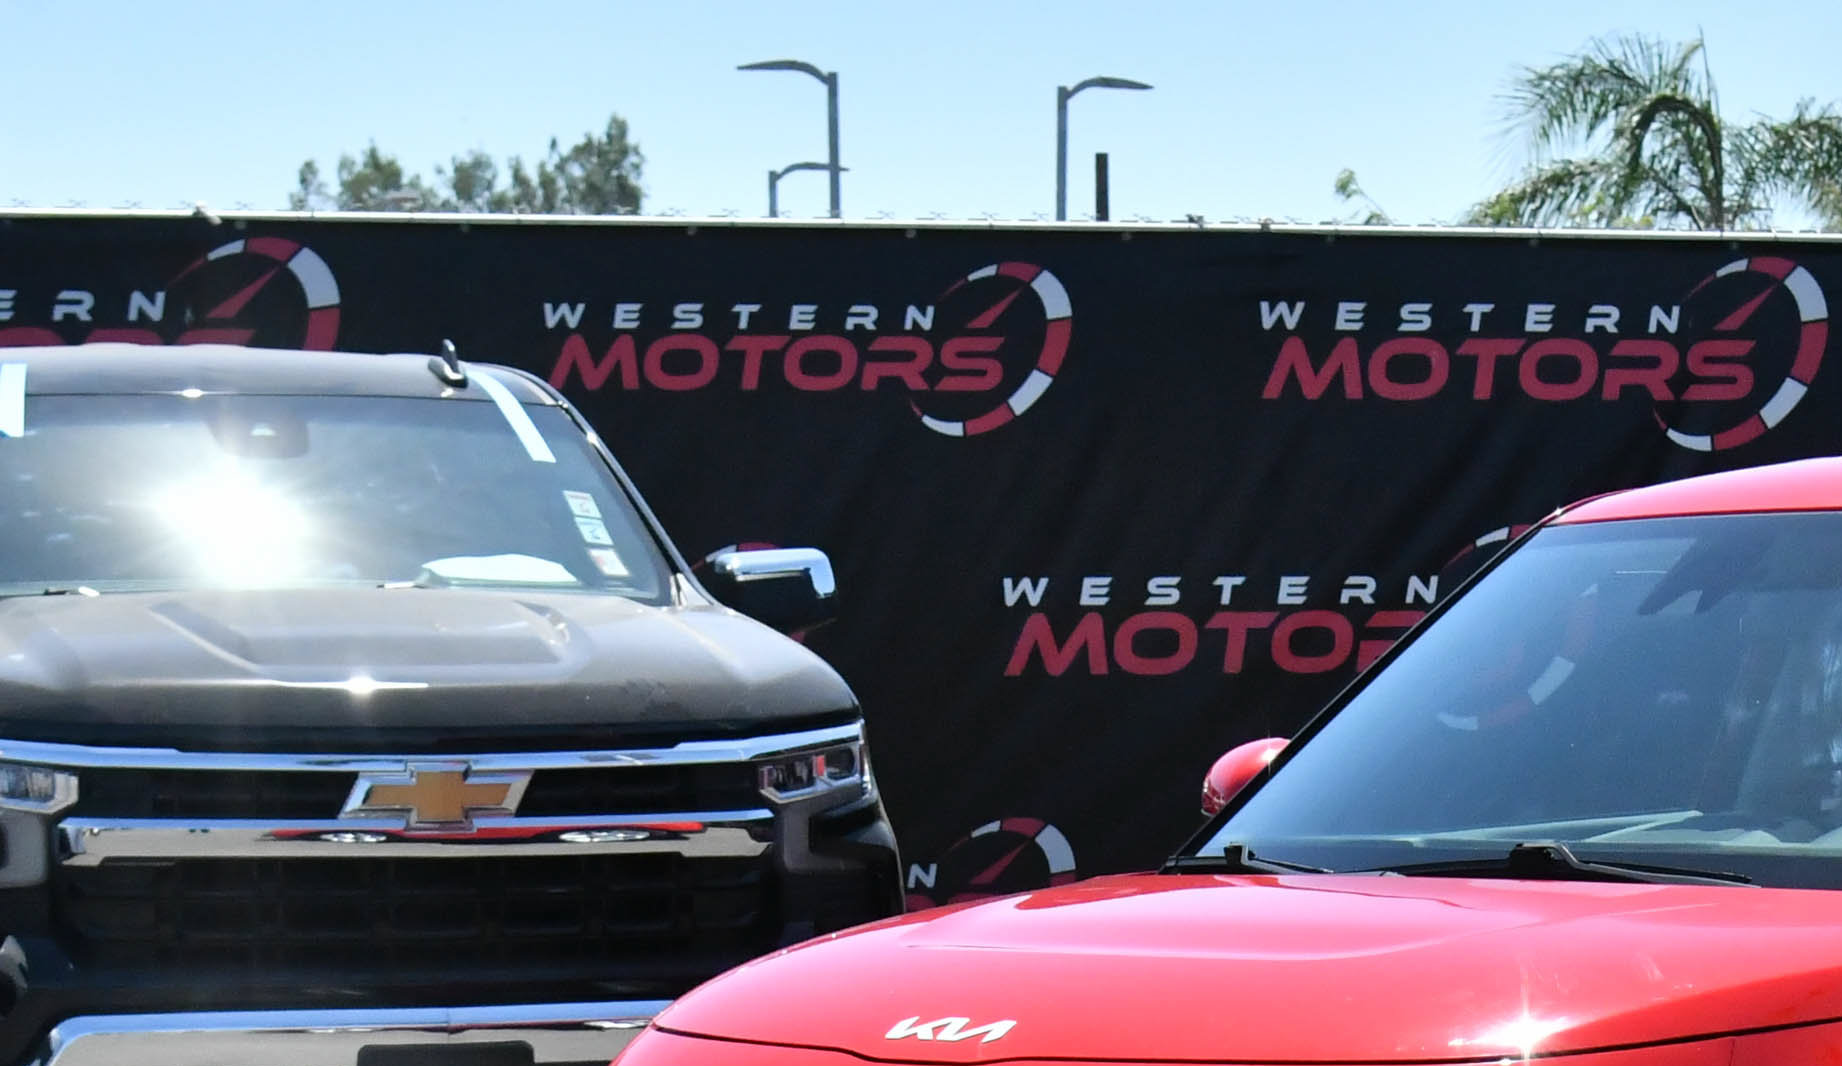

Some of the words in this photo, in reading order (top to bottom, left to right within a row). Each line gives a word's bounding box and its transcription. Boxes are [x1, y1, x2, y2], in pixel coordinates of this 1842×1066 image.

[543, 302, 935, 331] WESTERN
[1260, 301, 1680, 334] WESTERN
[549, 333, 1004, 392] MOTORS
[1263, 335, 1756, 401] MOTORS
[1003, 575, 1439, 607] WESTERN
